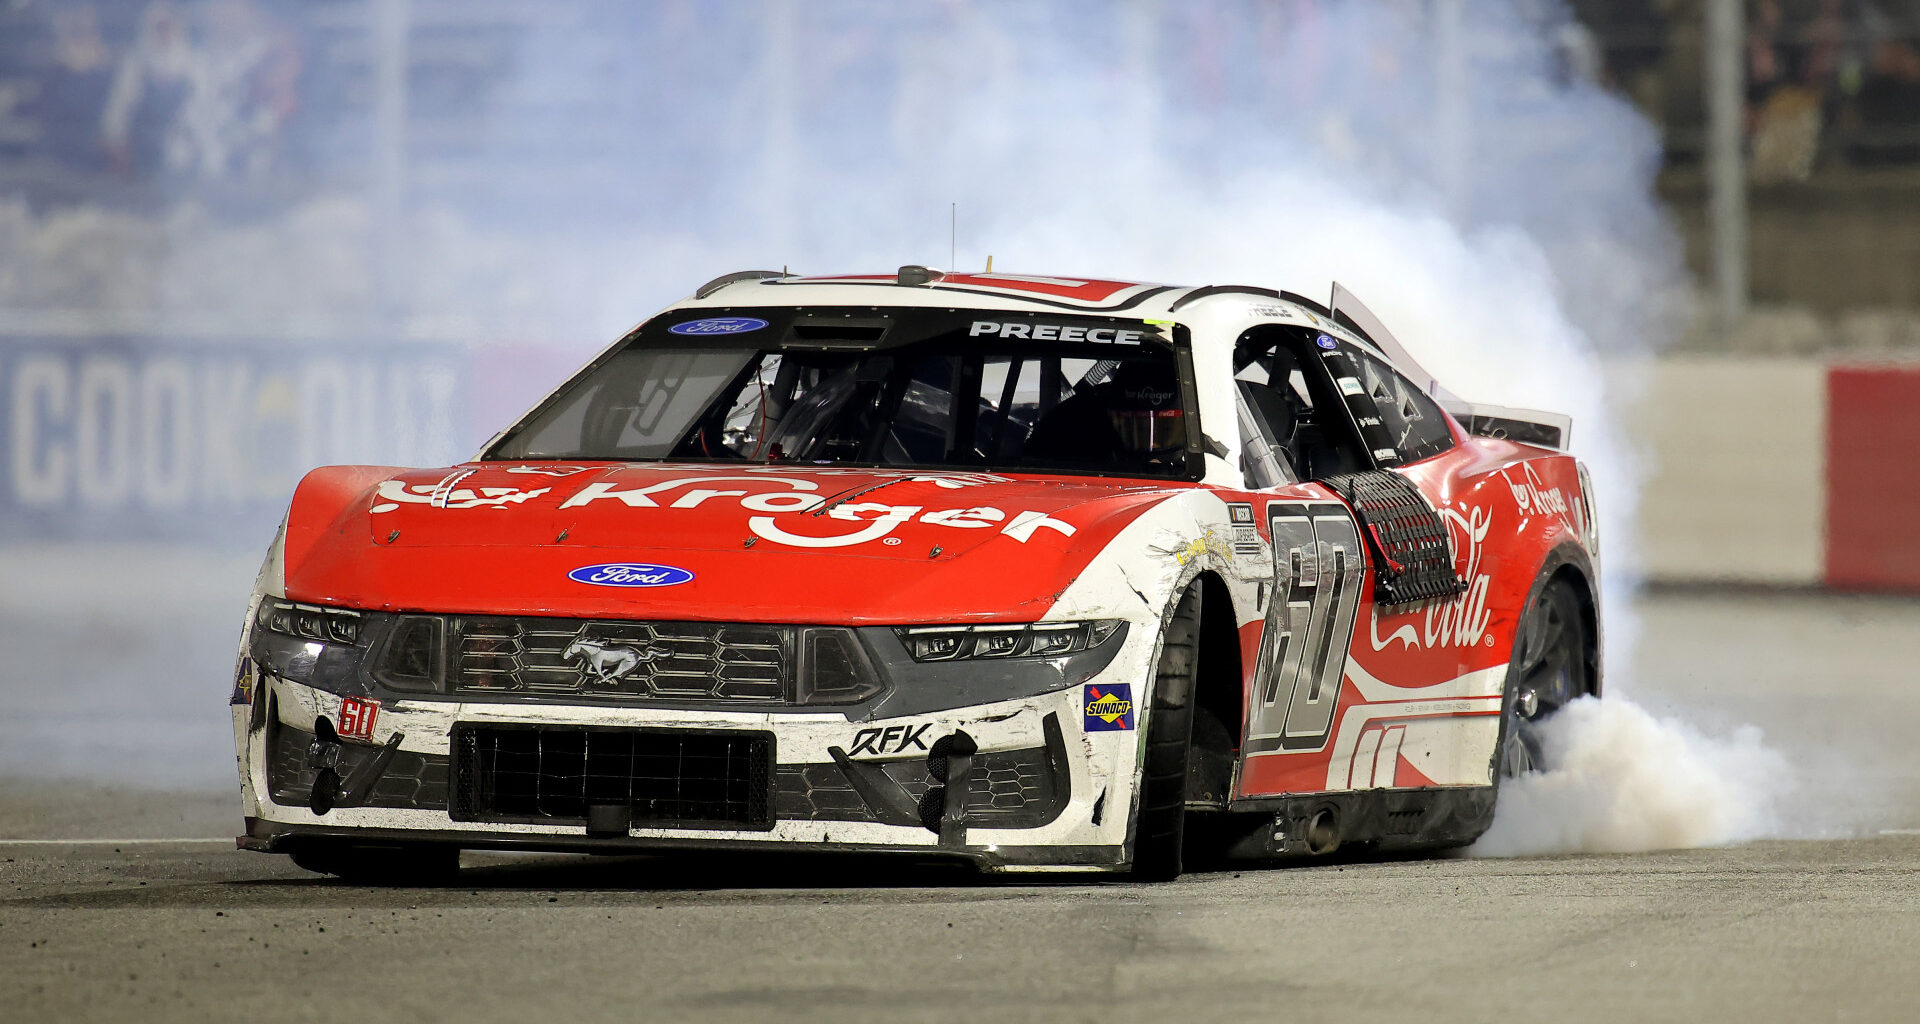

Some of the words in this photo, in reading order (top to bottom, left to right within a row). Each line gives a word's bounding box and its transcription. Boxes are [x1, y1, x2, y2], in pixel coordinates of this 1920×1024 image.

[969, 321, 1141, 346] PREECE
[1137, 386, 1175, 406] Kroger
[12, 354, 252, 505] COOK
[557, 476, 1077, 547] Kroger
[1523, 461, 1575, 536] Kroger
[591, 565, 671, 584] Ford
[1246, 500, 1366, 757] 60
[339, 698, 378, 740] 60
[1086, 701, 1129, 716] SUNOCO
[848, 722, 933, 756] RFK
